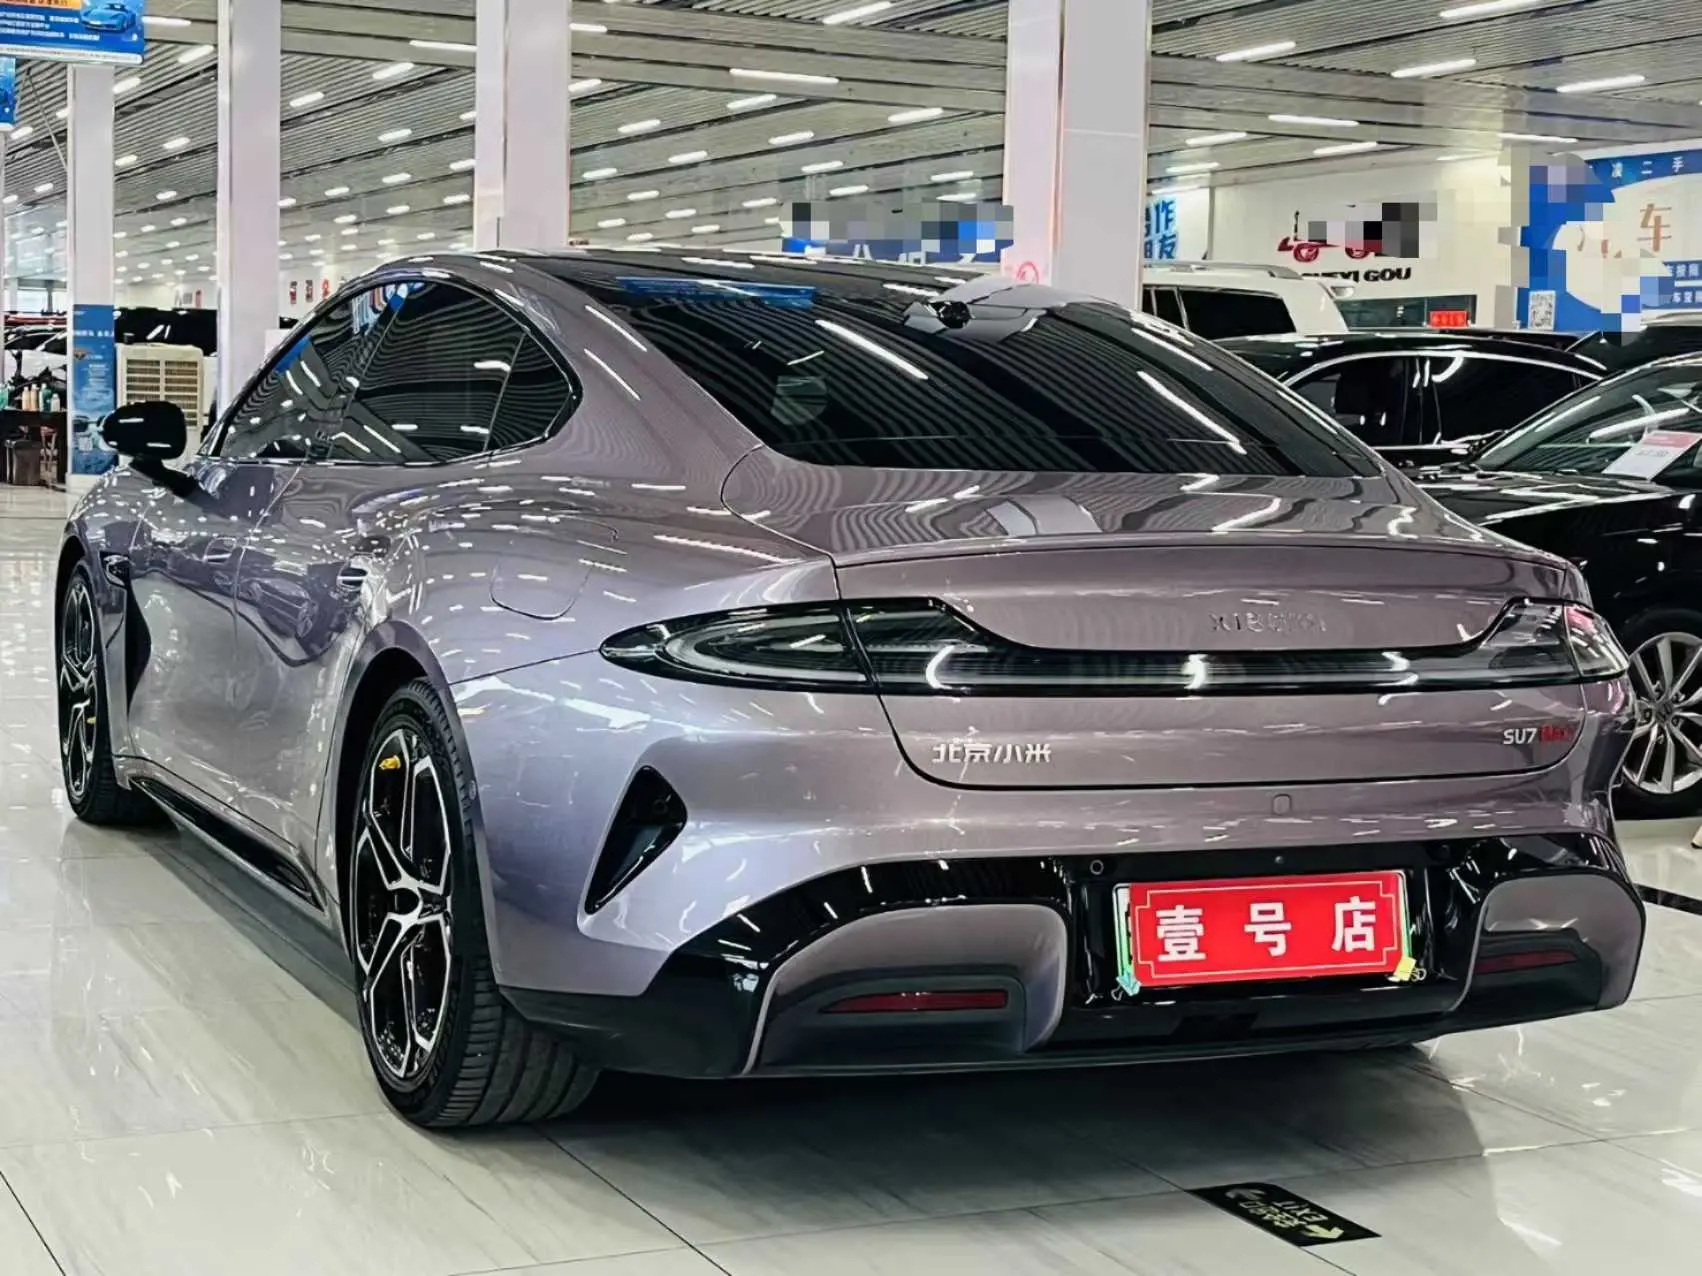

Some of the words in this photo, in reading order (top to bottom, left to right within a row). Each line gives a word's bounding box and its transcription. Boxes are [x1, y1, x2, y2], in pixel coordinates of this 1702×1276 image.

[1363, 267, 1411, 282] GOU
[1503, 727, 1537, 745] SU7
[932, 743, 1051, 764] 北京小米
[1156, 896, 1377, 962] 壹号店
